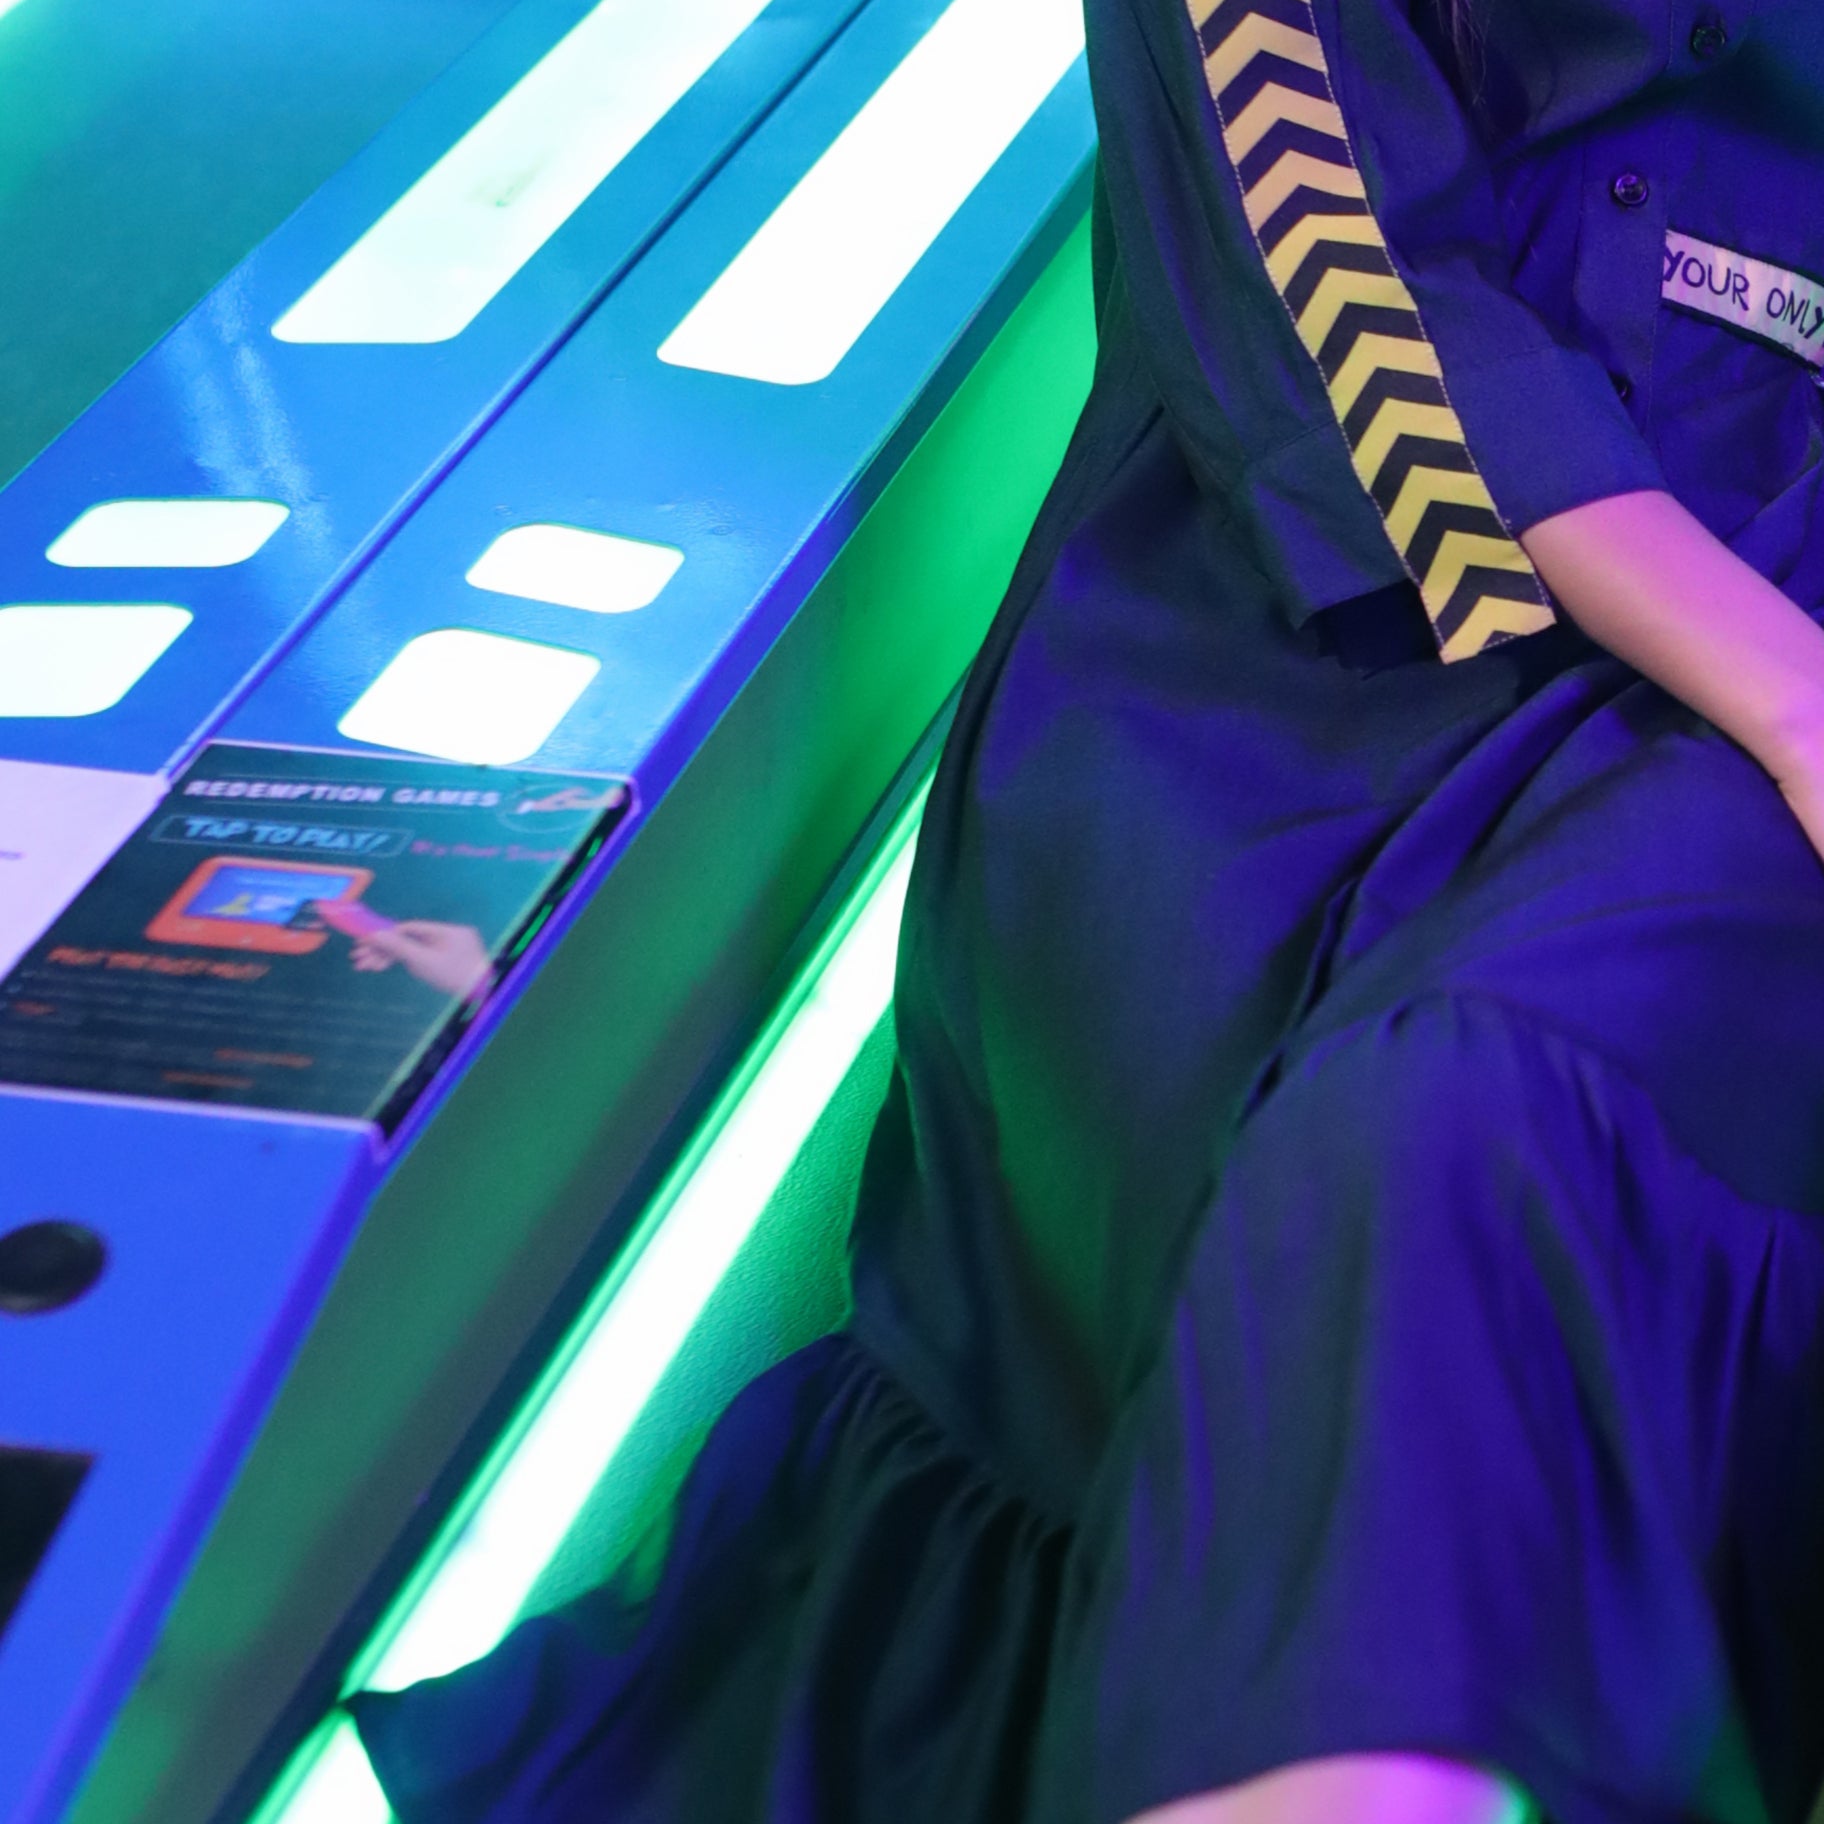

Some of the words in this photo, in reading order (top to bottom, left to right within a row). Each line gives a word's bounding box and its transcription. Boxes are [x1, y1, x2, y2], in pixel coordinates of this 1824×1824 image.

[1664, 246, 1749, 311] YOUR
[183, 779, 387, 804] REDEMPTION
[391, 787, 501, 808] GAMES
[184, 816, 249, 840] TAP
